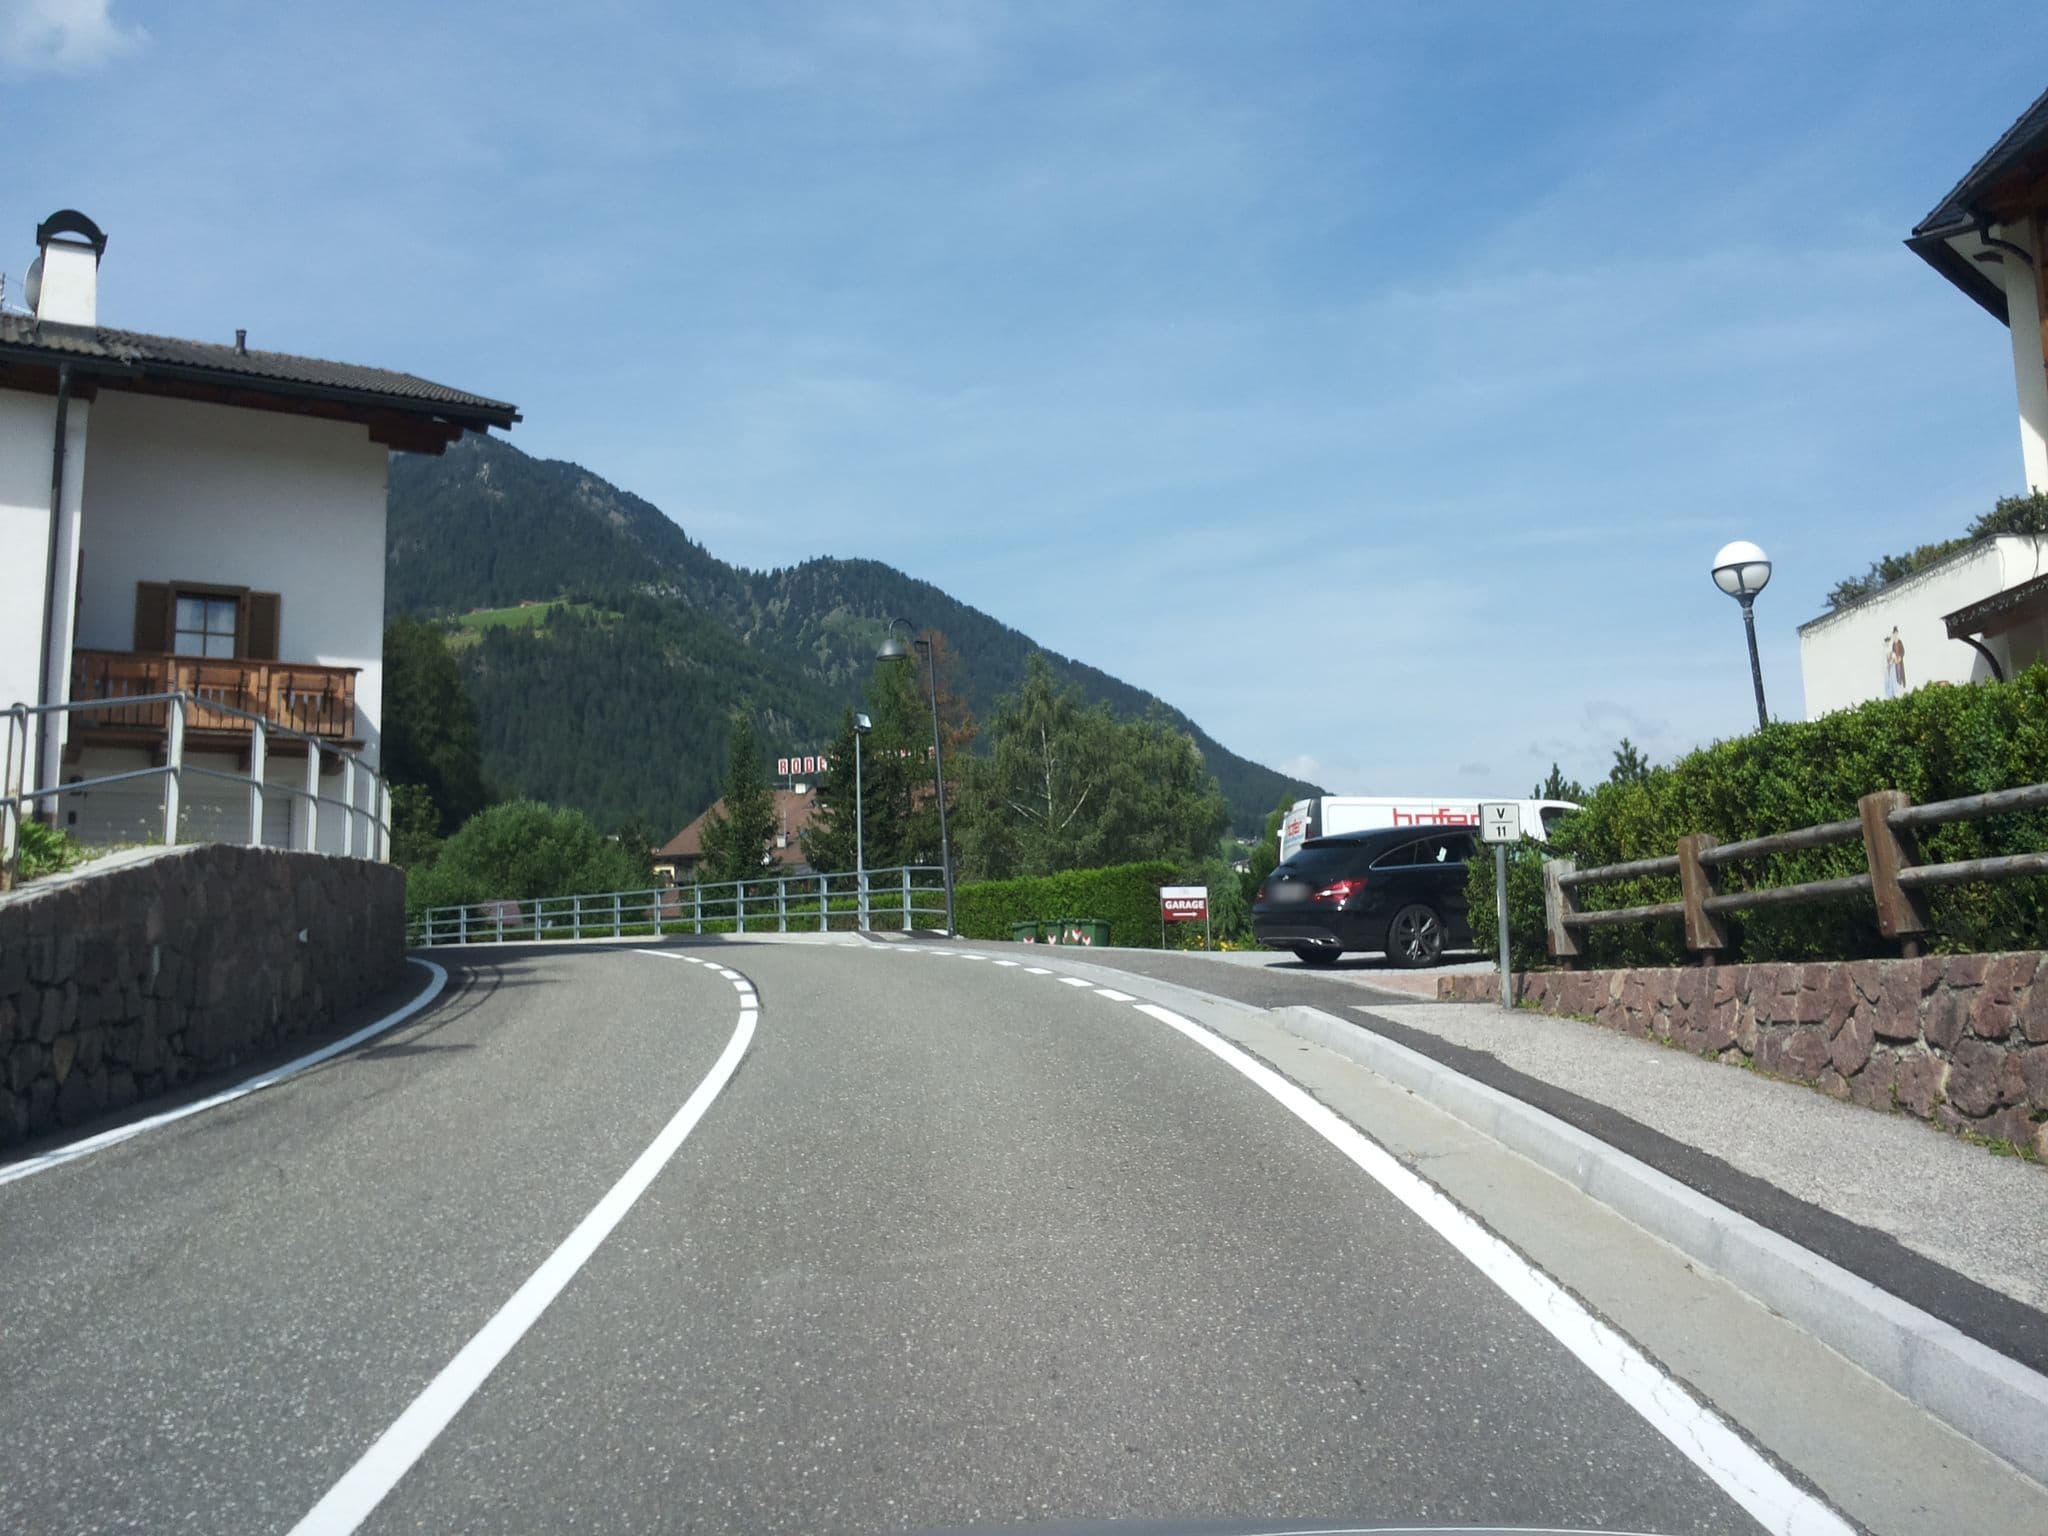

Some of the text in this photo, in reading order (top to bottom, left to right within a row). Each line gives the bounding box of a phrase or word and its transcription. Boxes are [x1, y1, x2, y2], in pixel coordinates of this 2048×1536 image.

[778, 754, 840, 775] RODE
[1496, 808, 1505, 819] V
[1496, 826, 1506, 837] 11
[1165, 900, 1205, 909] GARAGE
